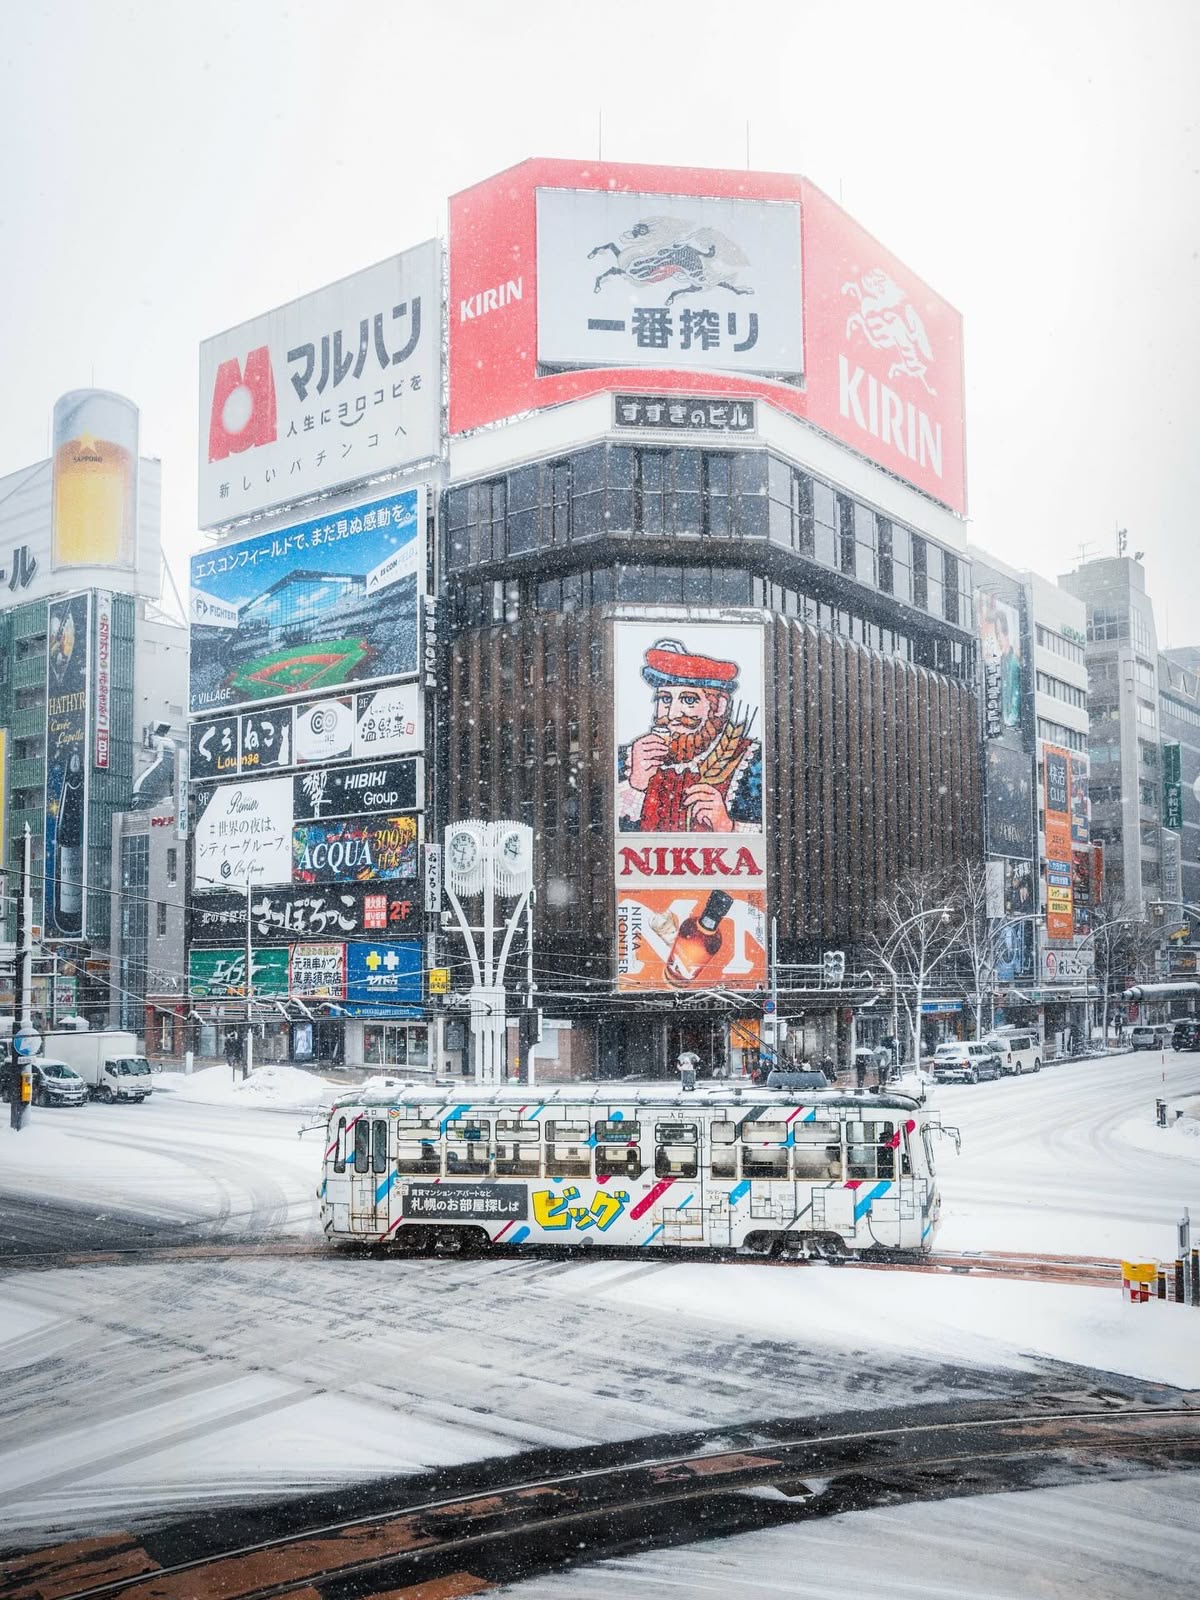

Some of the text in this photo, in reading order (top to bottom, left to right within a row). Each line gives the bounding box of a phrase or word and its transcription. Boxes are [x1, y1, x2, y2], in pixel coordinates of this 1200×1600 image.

[460, 277, 523, 322] KIRIN
[588, 307, 759, 352] 一番搾り
[287, 296, 421, 402] マルハン
[287, 374, 422, 438] 人生にヨロコビを
[620, 402, 748, 427] すすきのビル
[838, 353, 942, 479] KIRIN
[73, 455, 103, 464] SAPPORO
[219, 426, 407, 498] 新しいパチンコへ
[195, 504, 412, 579] エスコンフィールドで、まだ見ぬ感動を。
[198, 687, 231, 705] VILLAGE
[358, 697, 369, 709] 2F
[198, 718, 276, 764] くろねこ
[217, 753, 260, 770] Lounge
[344, 770, 387, 790] HIBIKI
[1050, 786, 1066, 803] CLUB
[198, 792, 209, 806] 9F
[363, 791, 399, 805] Group
[297, 840, 373, 873] ACQUA
[619, 846, 764, 878] NIKKA
[252, 896, 357, 935] さっぽろっこ
[389, 900, 410, 921] 2F
[618, 906, 628, 974] FRONTIER
[632, 906, 642, 951] NIKKA
[411, 1189, 492, 1197] 賃貸マンション・アパートなど
[411, 1198, 520, 1212] 札幌のお部屋探しは
[532, 1186, 630, 1232] ビッグ
